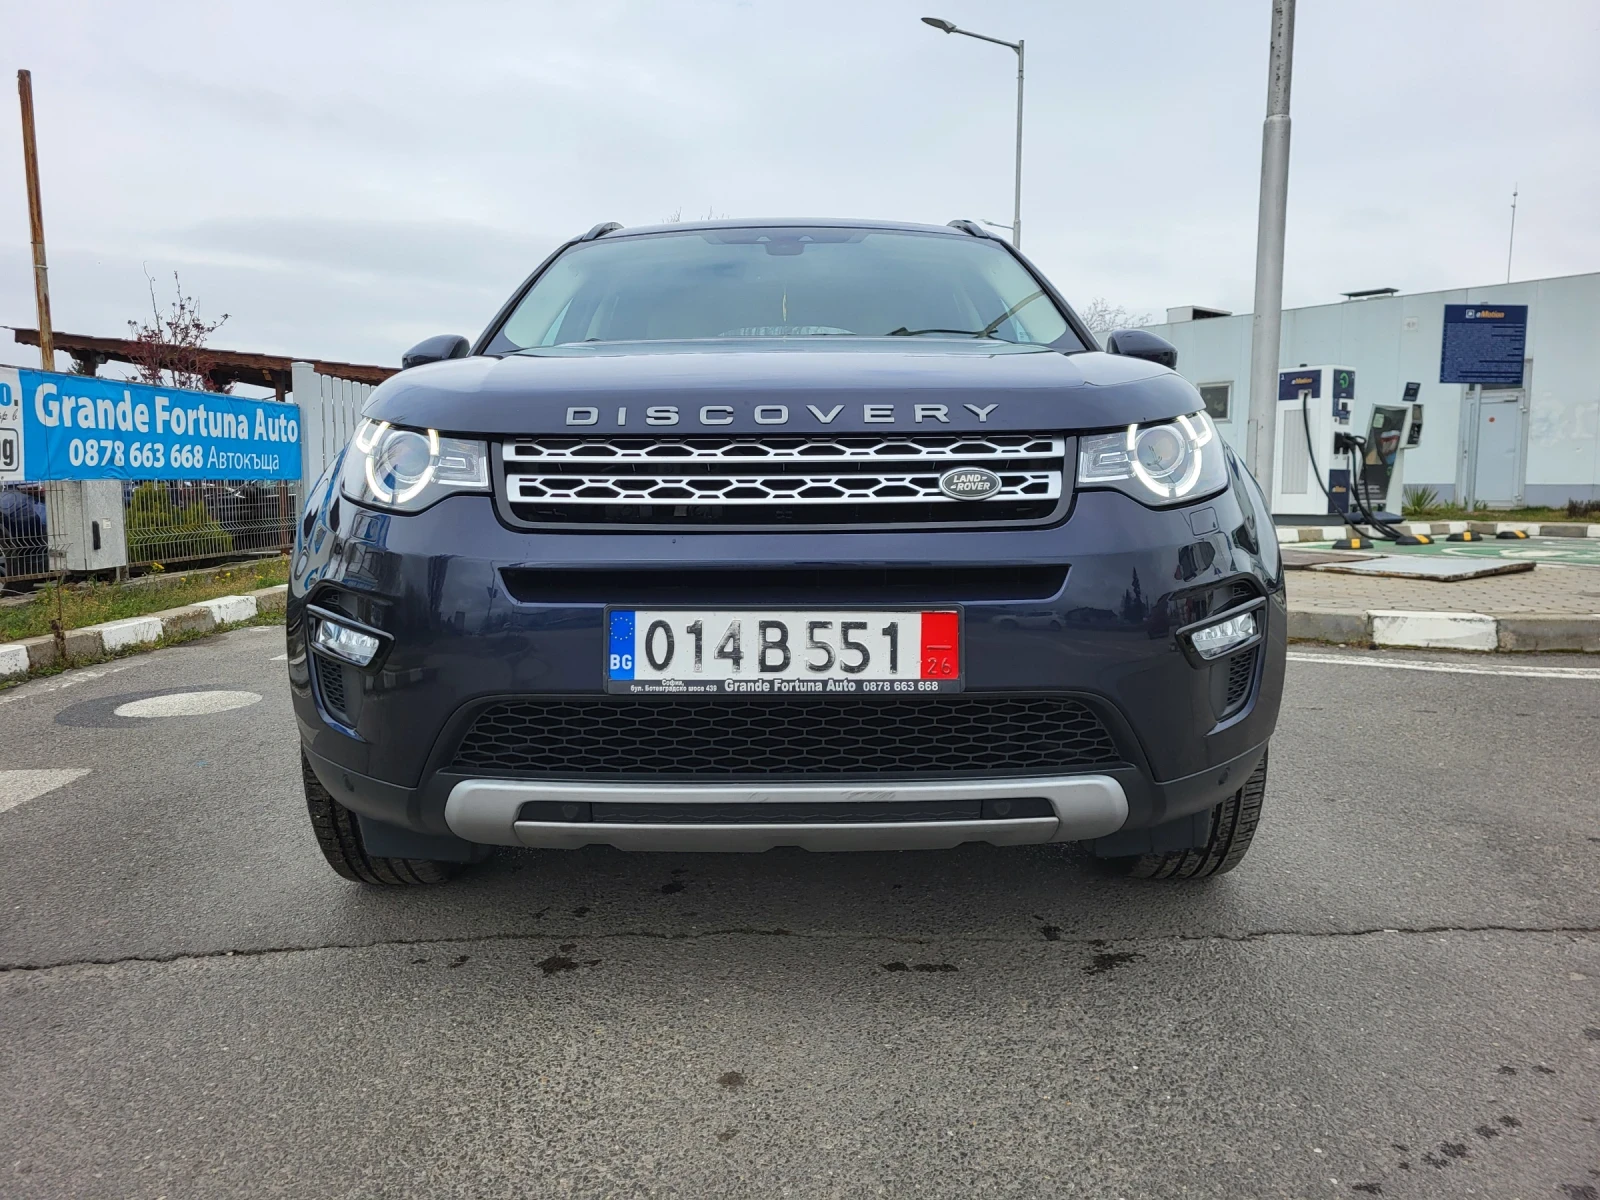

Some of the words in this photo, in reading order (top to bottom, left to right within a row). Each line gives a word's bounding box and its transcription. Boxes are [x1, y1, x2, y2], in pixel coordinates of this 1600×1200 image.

[34, 382, 149, 433] Grande
[155, 395, 249, 440] Fortuna
[254, 408, 299, 443] Auto
[566, 403, 999, 426] DISCOVERY
[69, 438, 125, 467] 0878
[129, 442, 165, 468] 663
[170, 443, 203, 469] 668
[207, 445, 280, 474] Автокъща
[953, 474, 981, 483] LAND
[957, 482, 990, 491] ROVER
[610, 654, 632, 670] BG
[927, 657, 951, 675] 26
[724, 679, 770, 692] Grande
[774, 679, 823, 692] Fortuna
[826, 680, 856, 692] Auto
[863, 681, 891, 692] 0878
[894, 681, 915, 692] 663
[918, 681, 939, 691] 668
